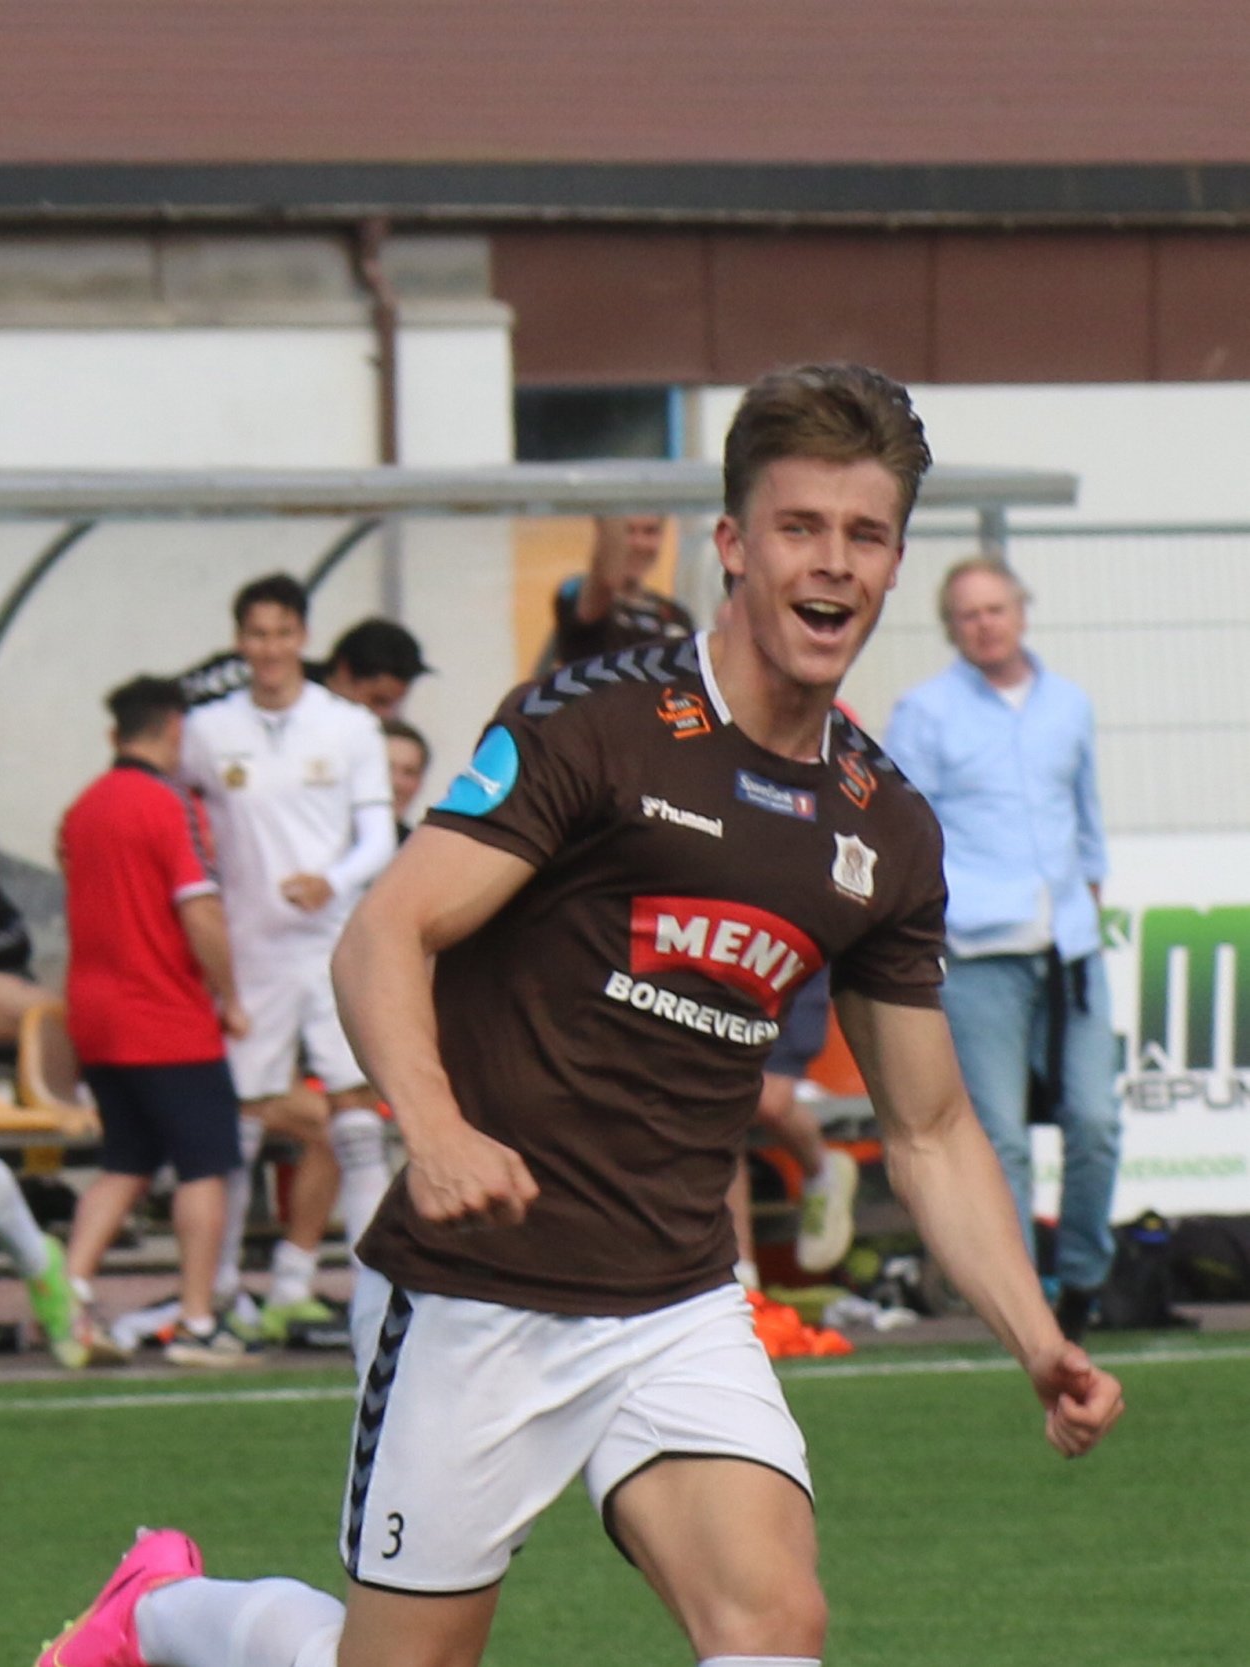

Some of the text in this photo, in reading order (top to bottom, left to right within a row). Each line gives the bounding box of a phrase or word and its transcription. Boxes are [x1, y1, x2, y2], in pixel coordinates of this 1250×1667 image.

[660, 799, 723, 838] hummel
[655, 914, 805, 993] MENY
[604, 970, 780, 1045] BORREVEIEN
[381, 1511, 405, 1560] 3
